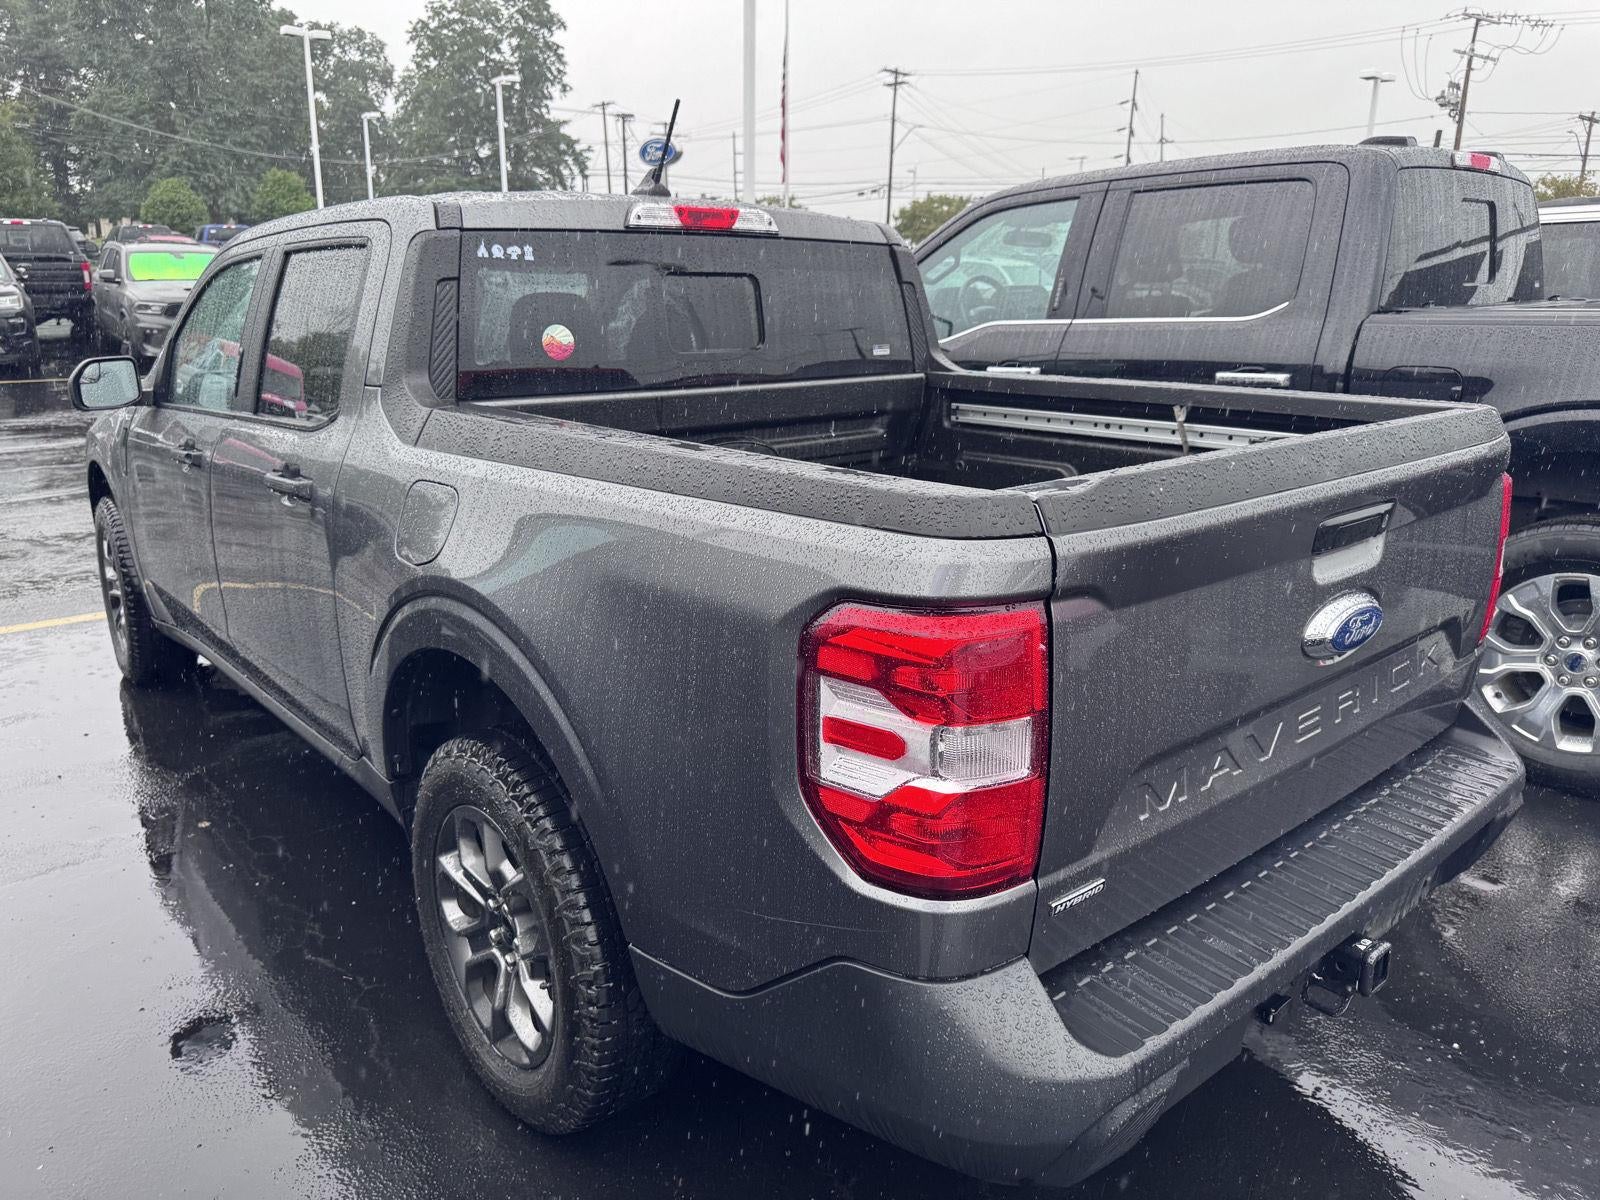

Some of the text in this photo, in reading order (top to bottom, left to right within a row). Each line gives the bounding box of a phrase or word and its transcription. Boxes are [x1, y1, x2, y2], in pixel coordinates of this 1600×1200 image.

[1342, 611, 1378, 647] Ford
[1138, 642, 1438, 821] MAVERICK
[1054, 883, 1105, 914] HYBRID
